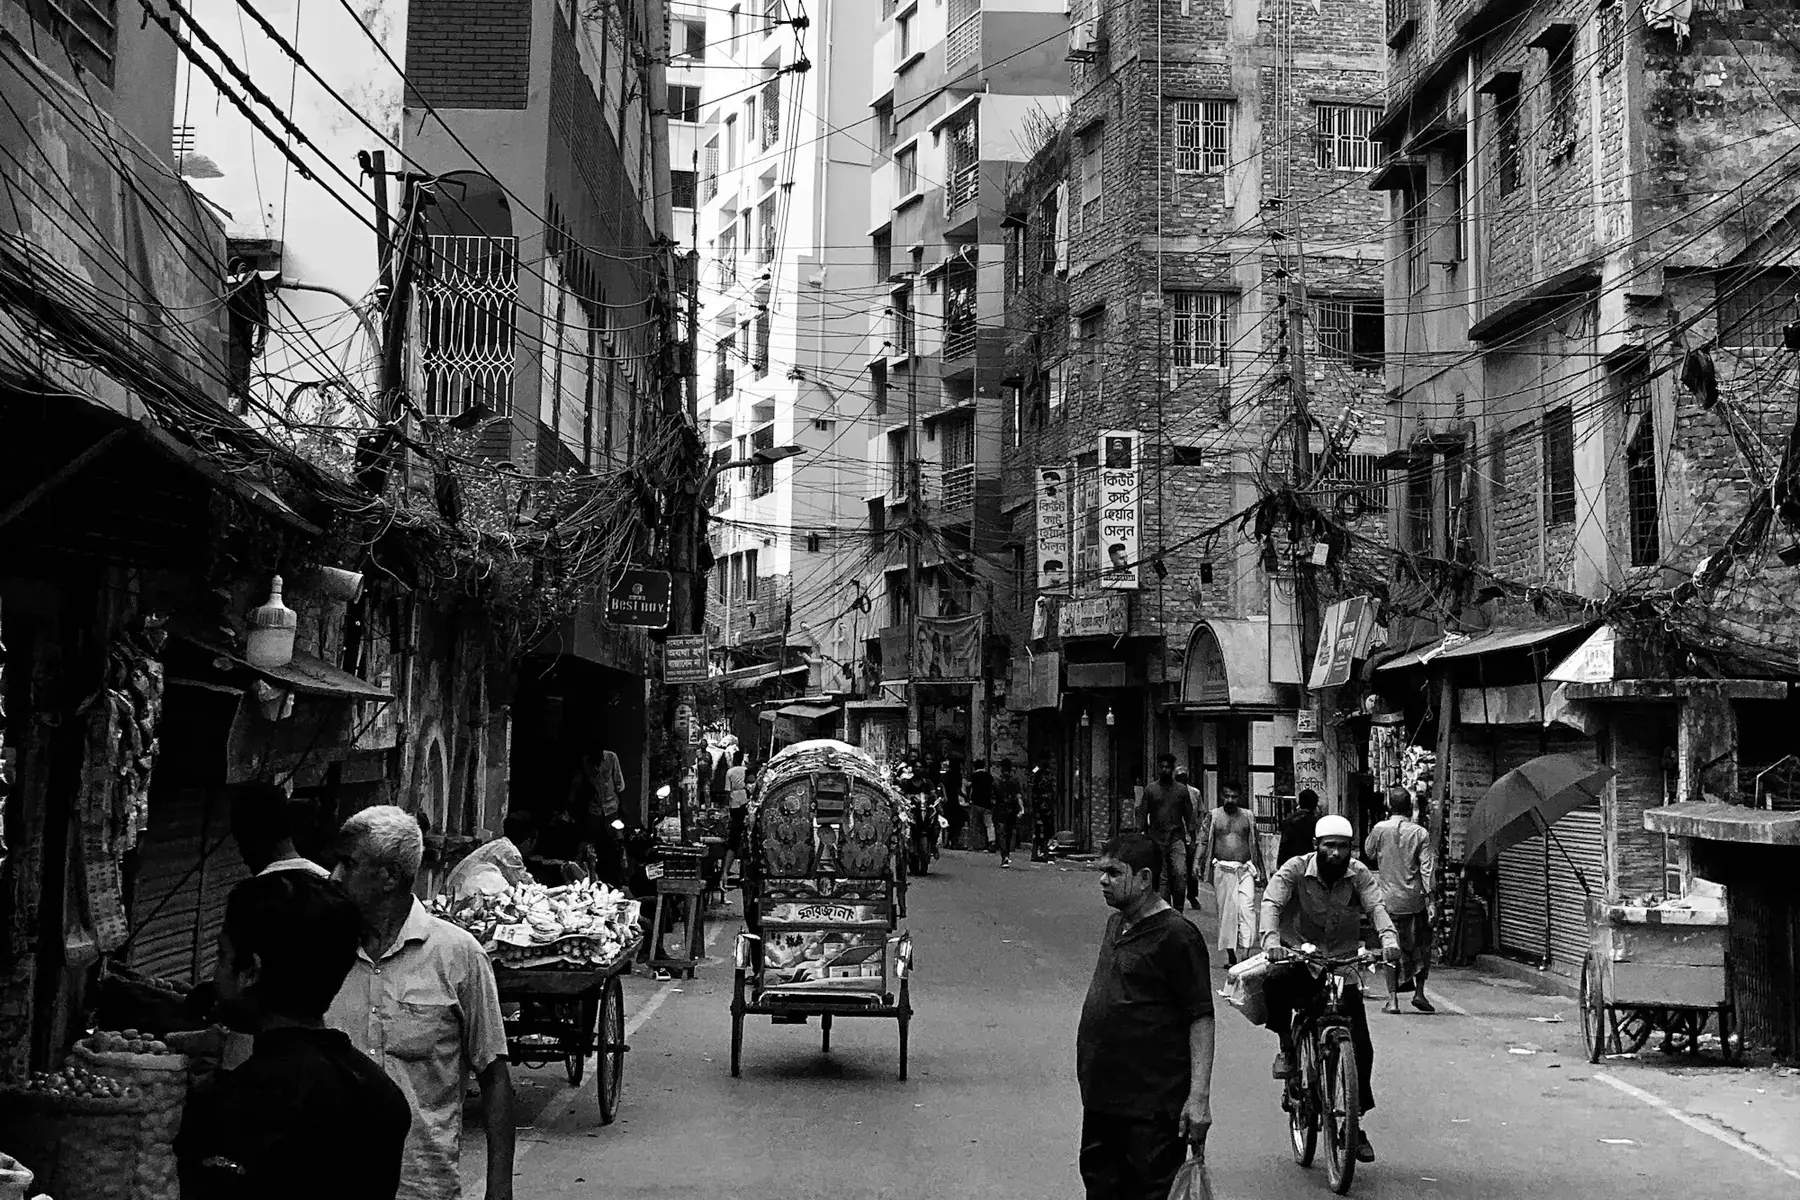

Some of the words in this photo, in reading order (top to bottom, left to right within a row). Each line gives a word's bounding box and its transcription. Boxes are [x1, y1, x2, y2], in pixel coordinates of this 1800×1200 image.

[1103, 471, 1135, 486] কিউট
[1107, 489, 1130, 503] কাট
[1039, 499, 1066, 512] কিউট
[1042, 514, 1062, 524] কাট
[1104, 509, 1135, 521] হেয়ার
[1104, 525, 1135, 541] সেলুন
